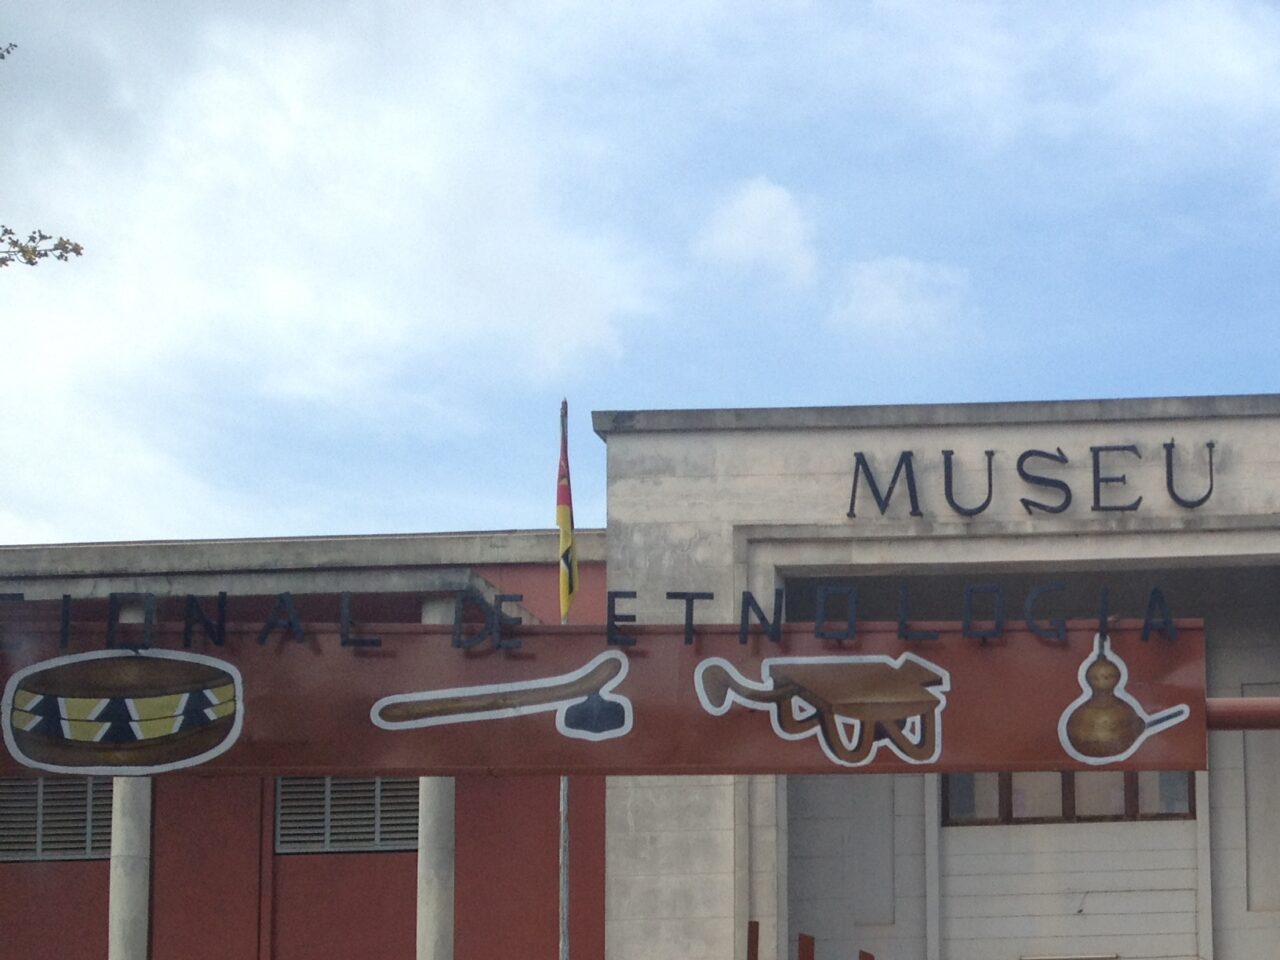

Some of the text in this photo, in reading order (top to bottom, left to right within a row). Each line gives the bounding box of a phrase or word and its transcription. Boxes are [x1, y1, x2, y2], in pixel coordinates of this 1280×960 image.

[846, 439, 1216, 518] MUSEU
[451, 593, 525, 650] DE
[605, 584, 1179, 646] ETNOLOGIA
